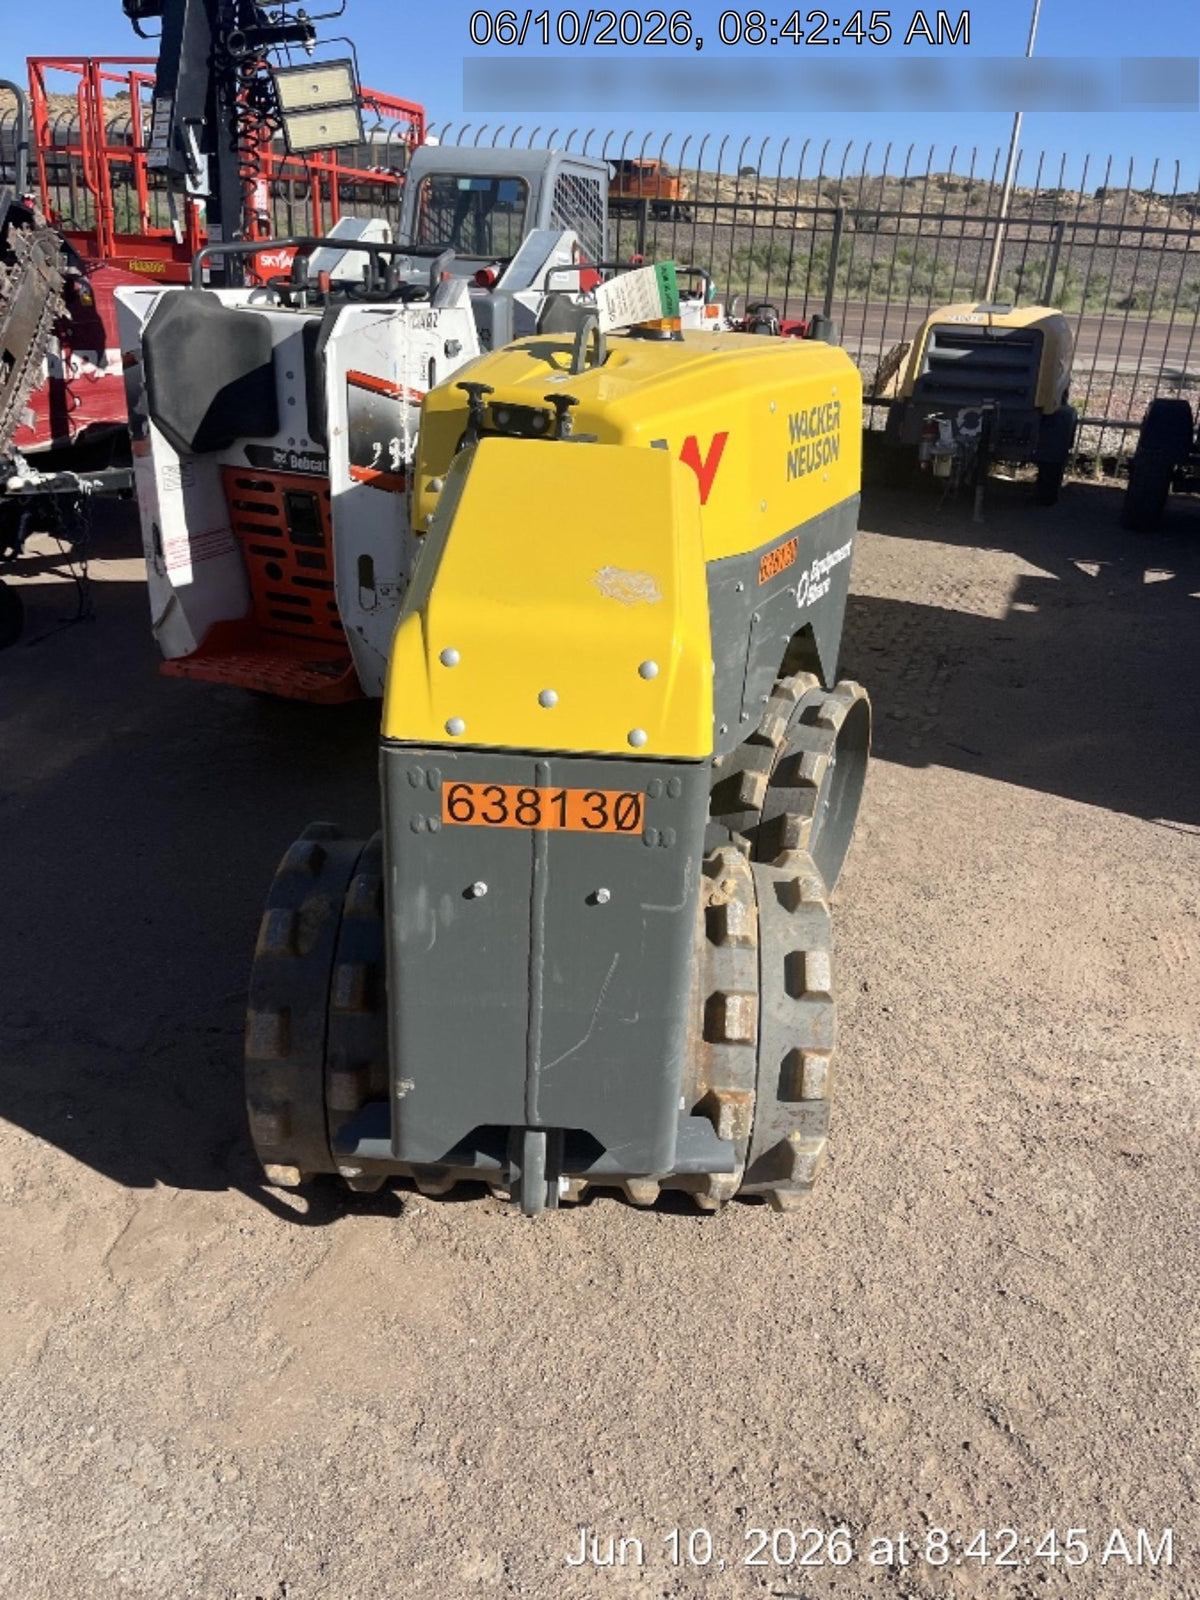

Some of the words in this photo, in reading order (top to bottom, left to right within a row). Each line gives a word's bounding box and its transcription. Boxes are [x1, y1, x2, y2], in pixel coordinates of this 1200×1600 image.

[788, 400, 840, 445] WACKER
[787, 432, 840, 482] NEUSON
[447, 783, 641, 831] 638130
